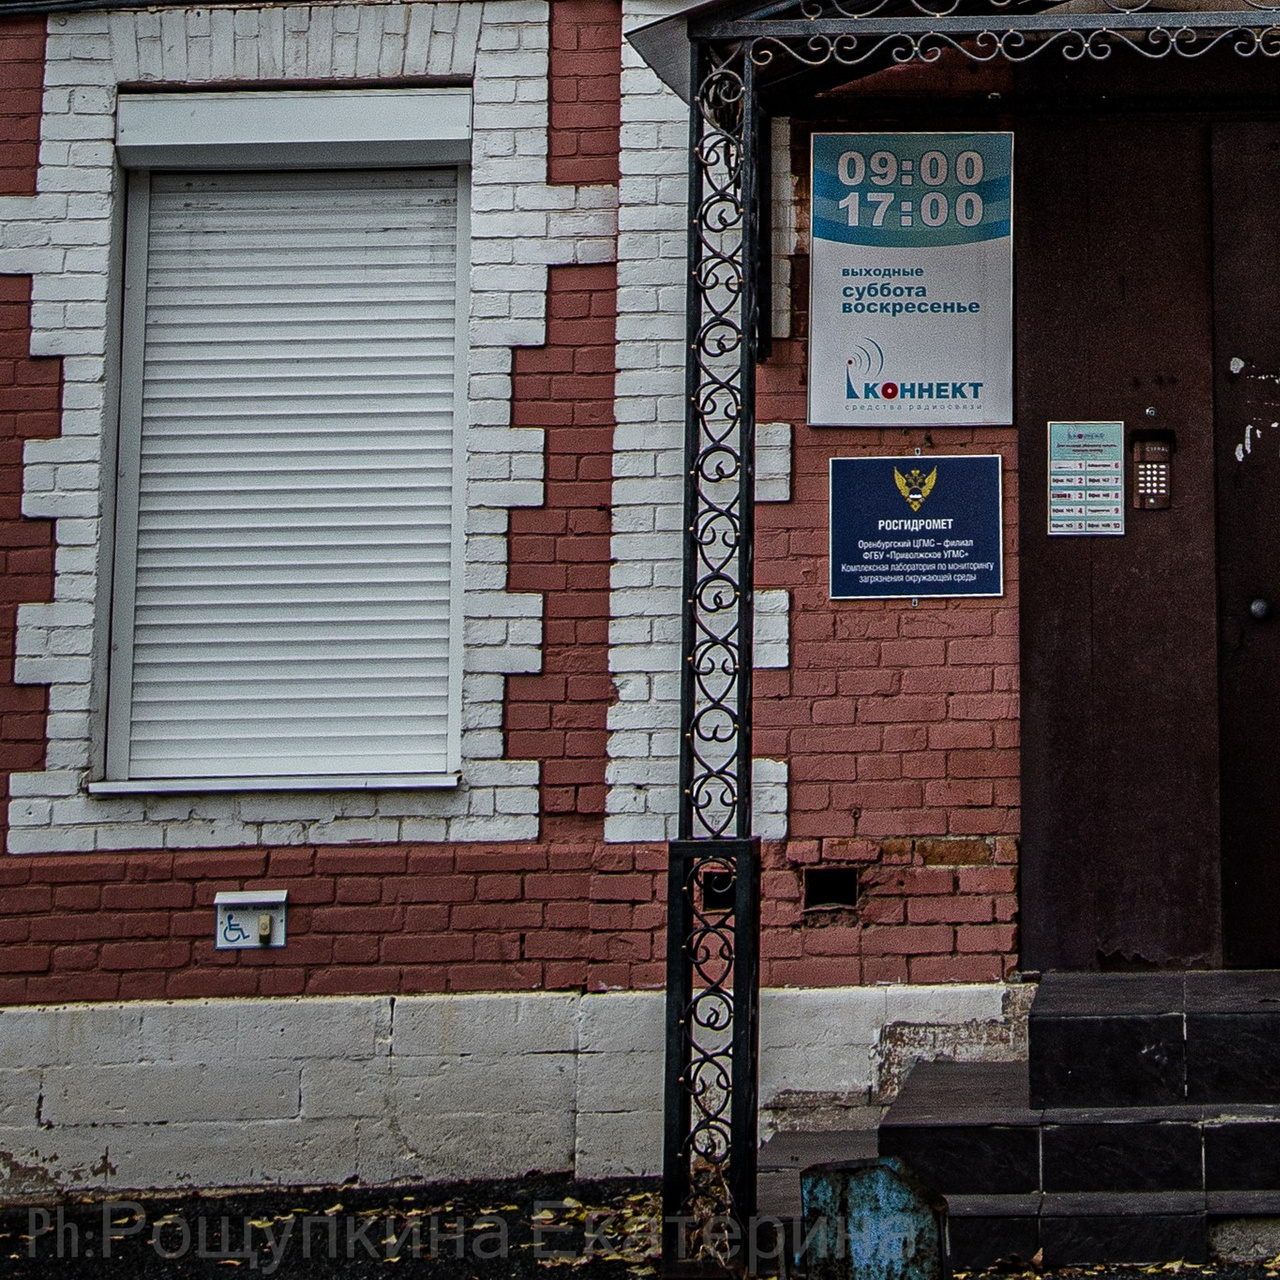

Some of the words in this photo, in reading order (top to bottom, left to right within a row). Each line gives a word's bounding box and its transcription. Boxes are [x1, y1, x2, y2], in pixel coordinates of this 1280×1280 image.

[837, 150, 985, 187] 09:00
[837, 192, 985, 228] 17:00
[841, 266, 925, 278] выходные
[841, 283, 927, 299] суббота
[841, 300, 981, 317] воскресенье
[864, 382, 984, 400] КОННЕКТ
[878, 519, 954, 532] РОСГИДРОМЕТ
